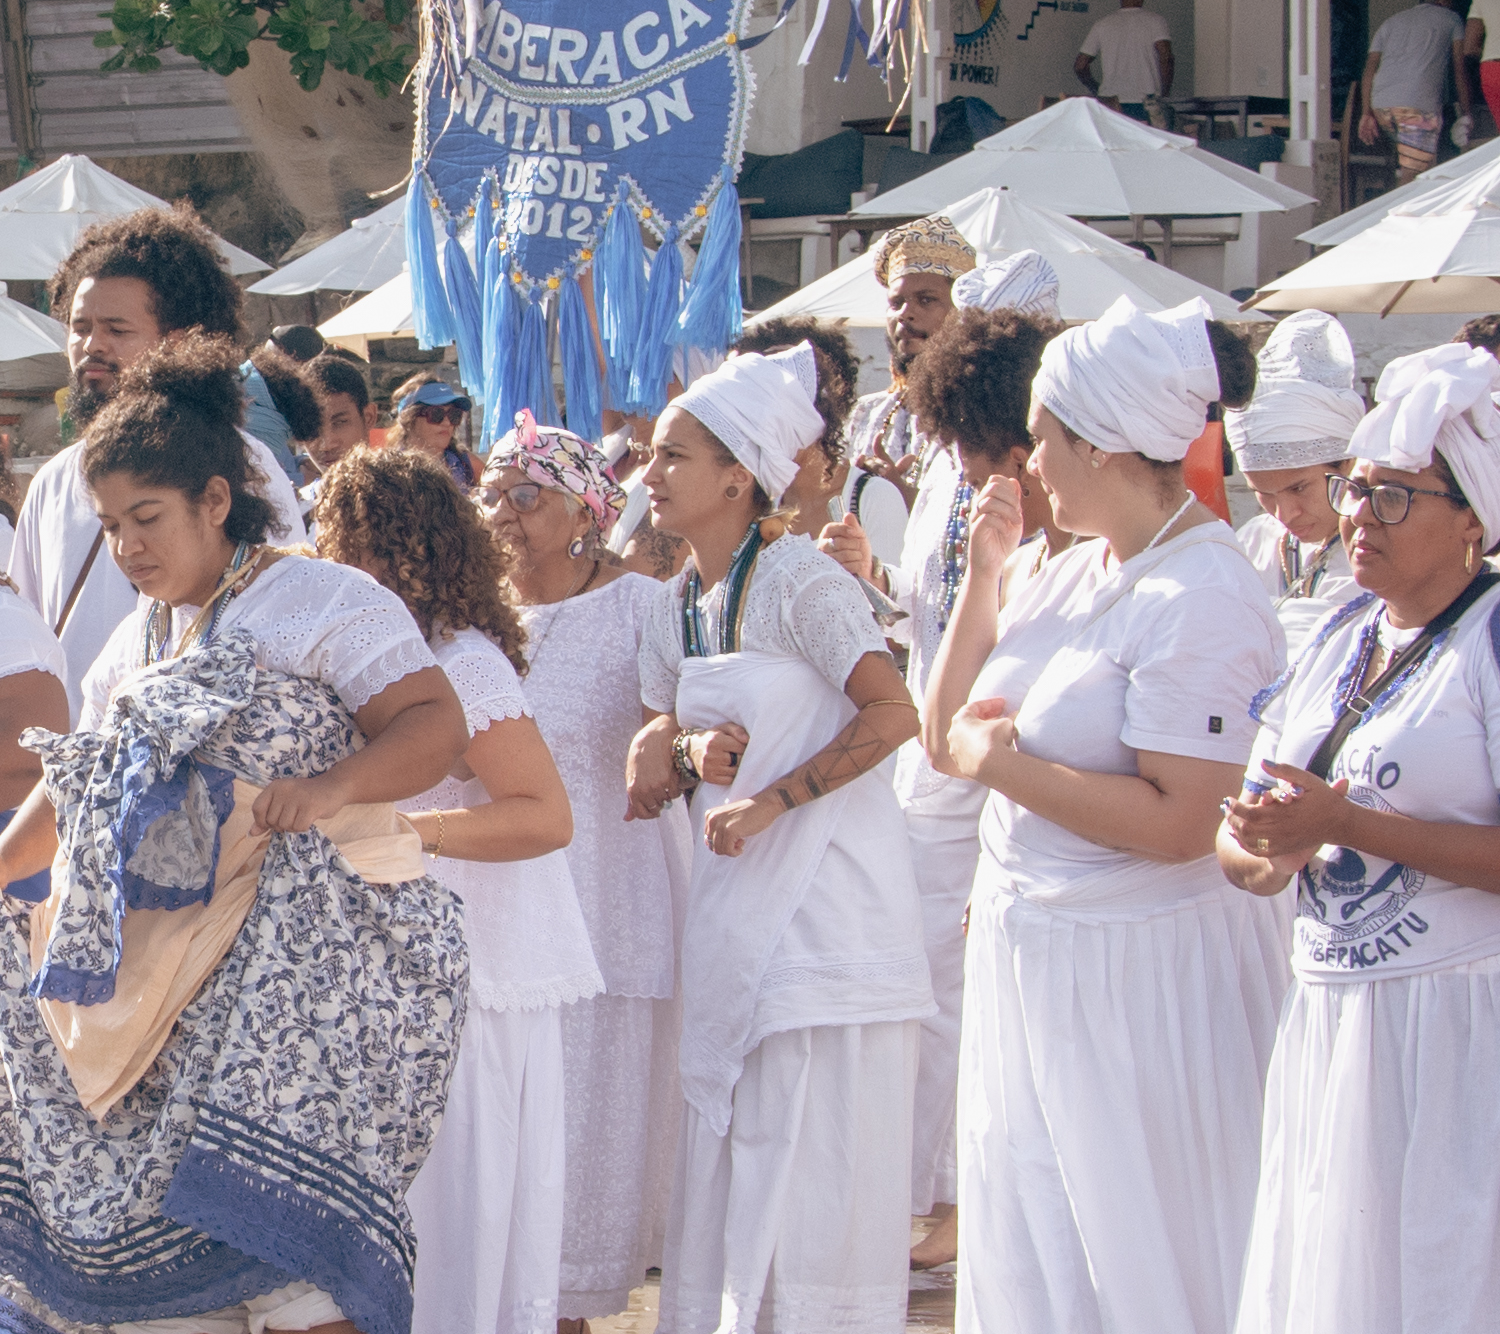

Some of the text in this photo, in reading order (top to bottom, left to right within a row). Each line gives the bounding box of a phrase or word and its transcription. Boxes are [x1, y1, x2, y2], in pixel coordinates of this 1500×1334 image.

[453, 71, 695, 156] NATAL RN
[501, 152, 608, 203] DESDE
[505, 197, 596, 243] 2012
